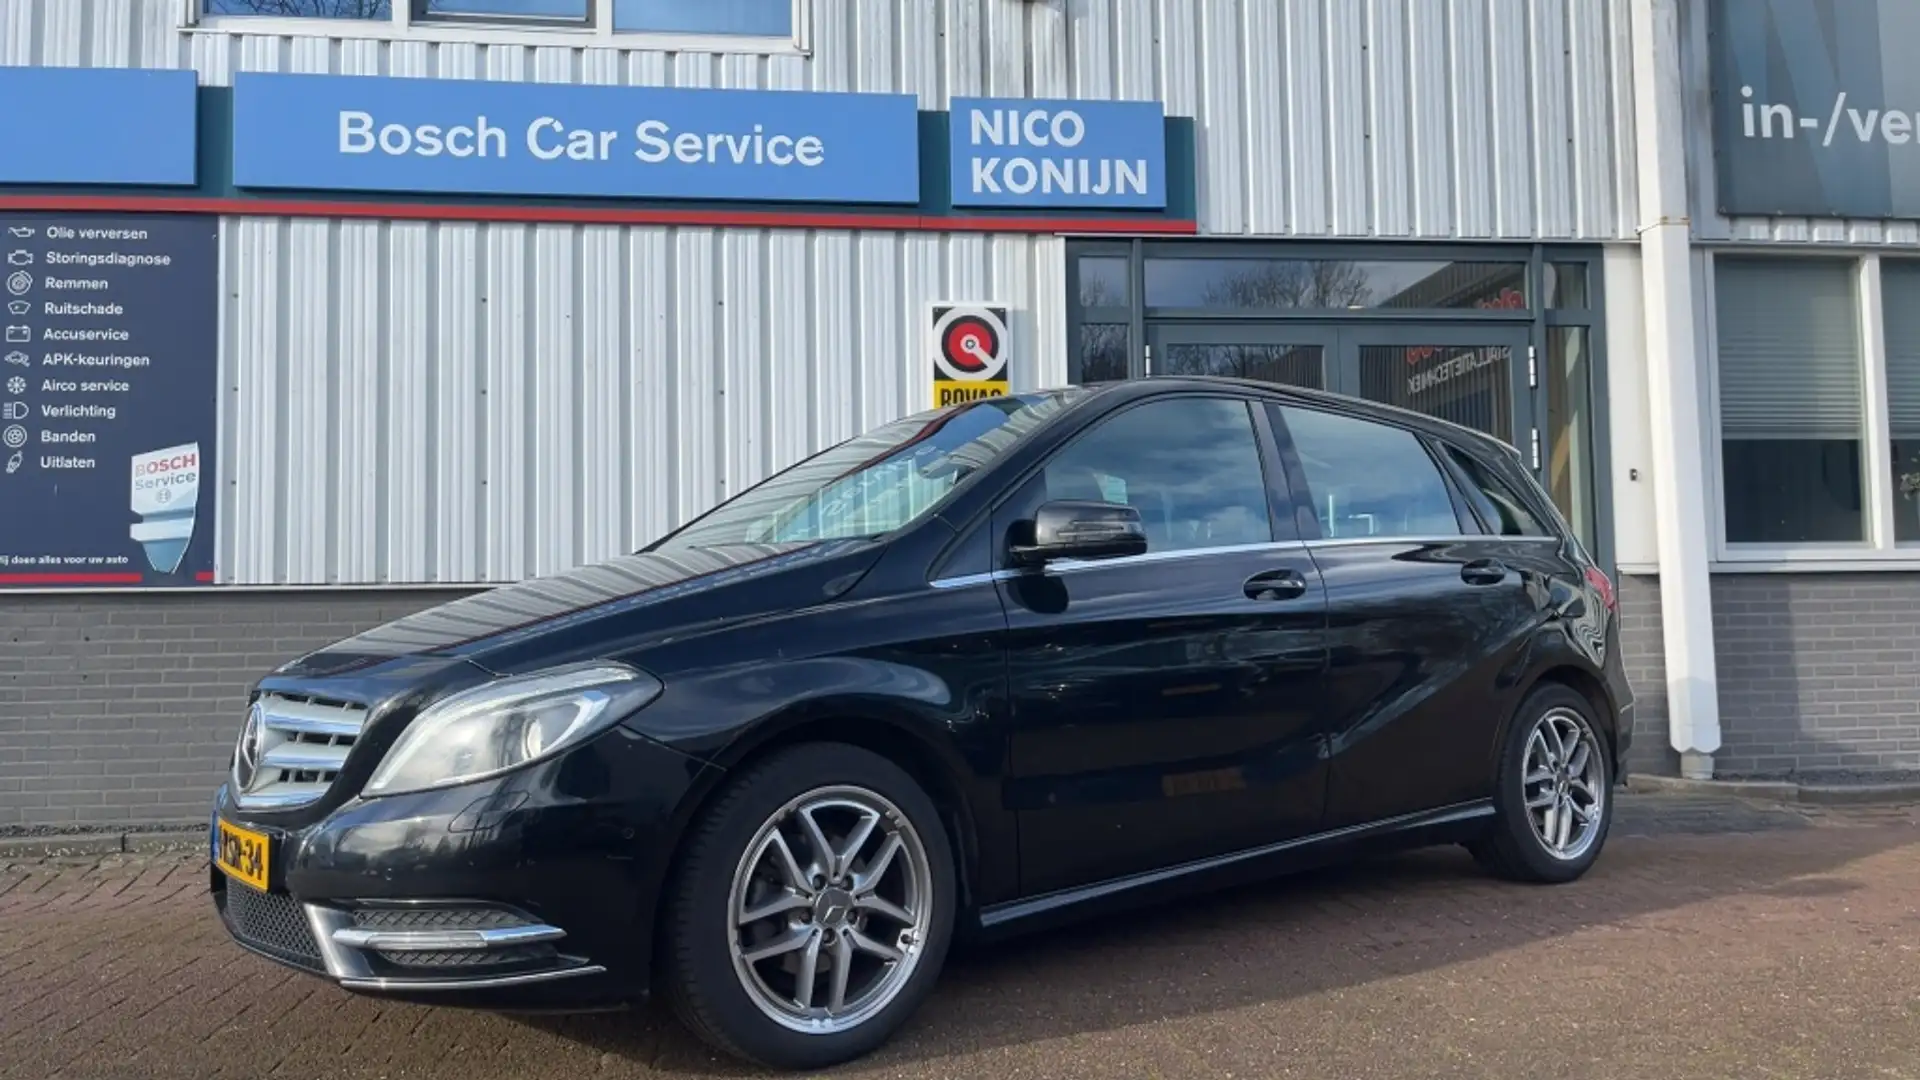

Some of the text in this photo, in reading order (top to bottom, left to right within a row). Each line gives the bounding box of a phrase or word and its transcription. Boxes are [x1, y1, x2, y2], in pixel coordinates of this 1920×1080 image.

[970, 108, 1086, 148] NICO
[339, 110, 825, 167] Bosch Car Service
[971, 156, 1148, 195] KONIJN
[46, 226, 148, 240] Olie verversen
[45, 251, 172, 267] Storingsdiagnose
[45, 276, 109, 290] Remmen
[44, 302, 124, 315] Ruitschade
[43, 328, 130, 341] Accuservice
[42, 353, 150, 368] APK-keuringen
[41, 379, 130, 392] Airco service
[41, 404, 116, 419] Verlichting
[40, 430, 96, 443] Banden
[40, 456, 96, 469] Uitlaten
[135, 453, 197, 478] BOSCH
[135, 472, 197, 491] Service
[63, 556, 86, 565] voor
[88, 556, 104, 565] uw
[105, 555, 129, 565] auto
